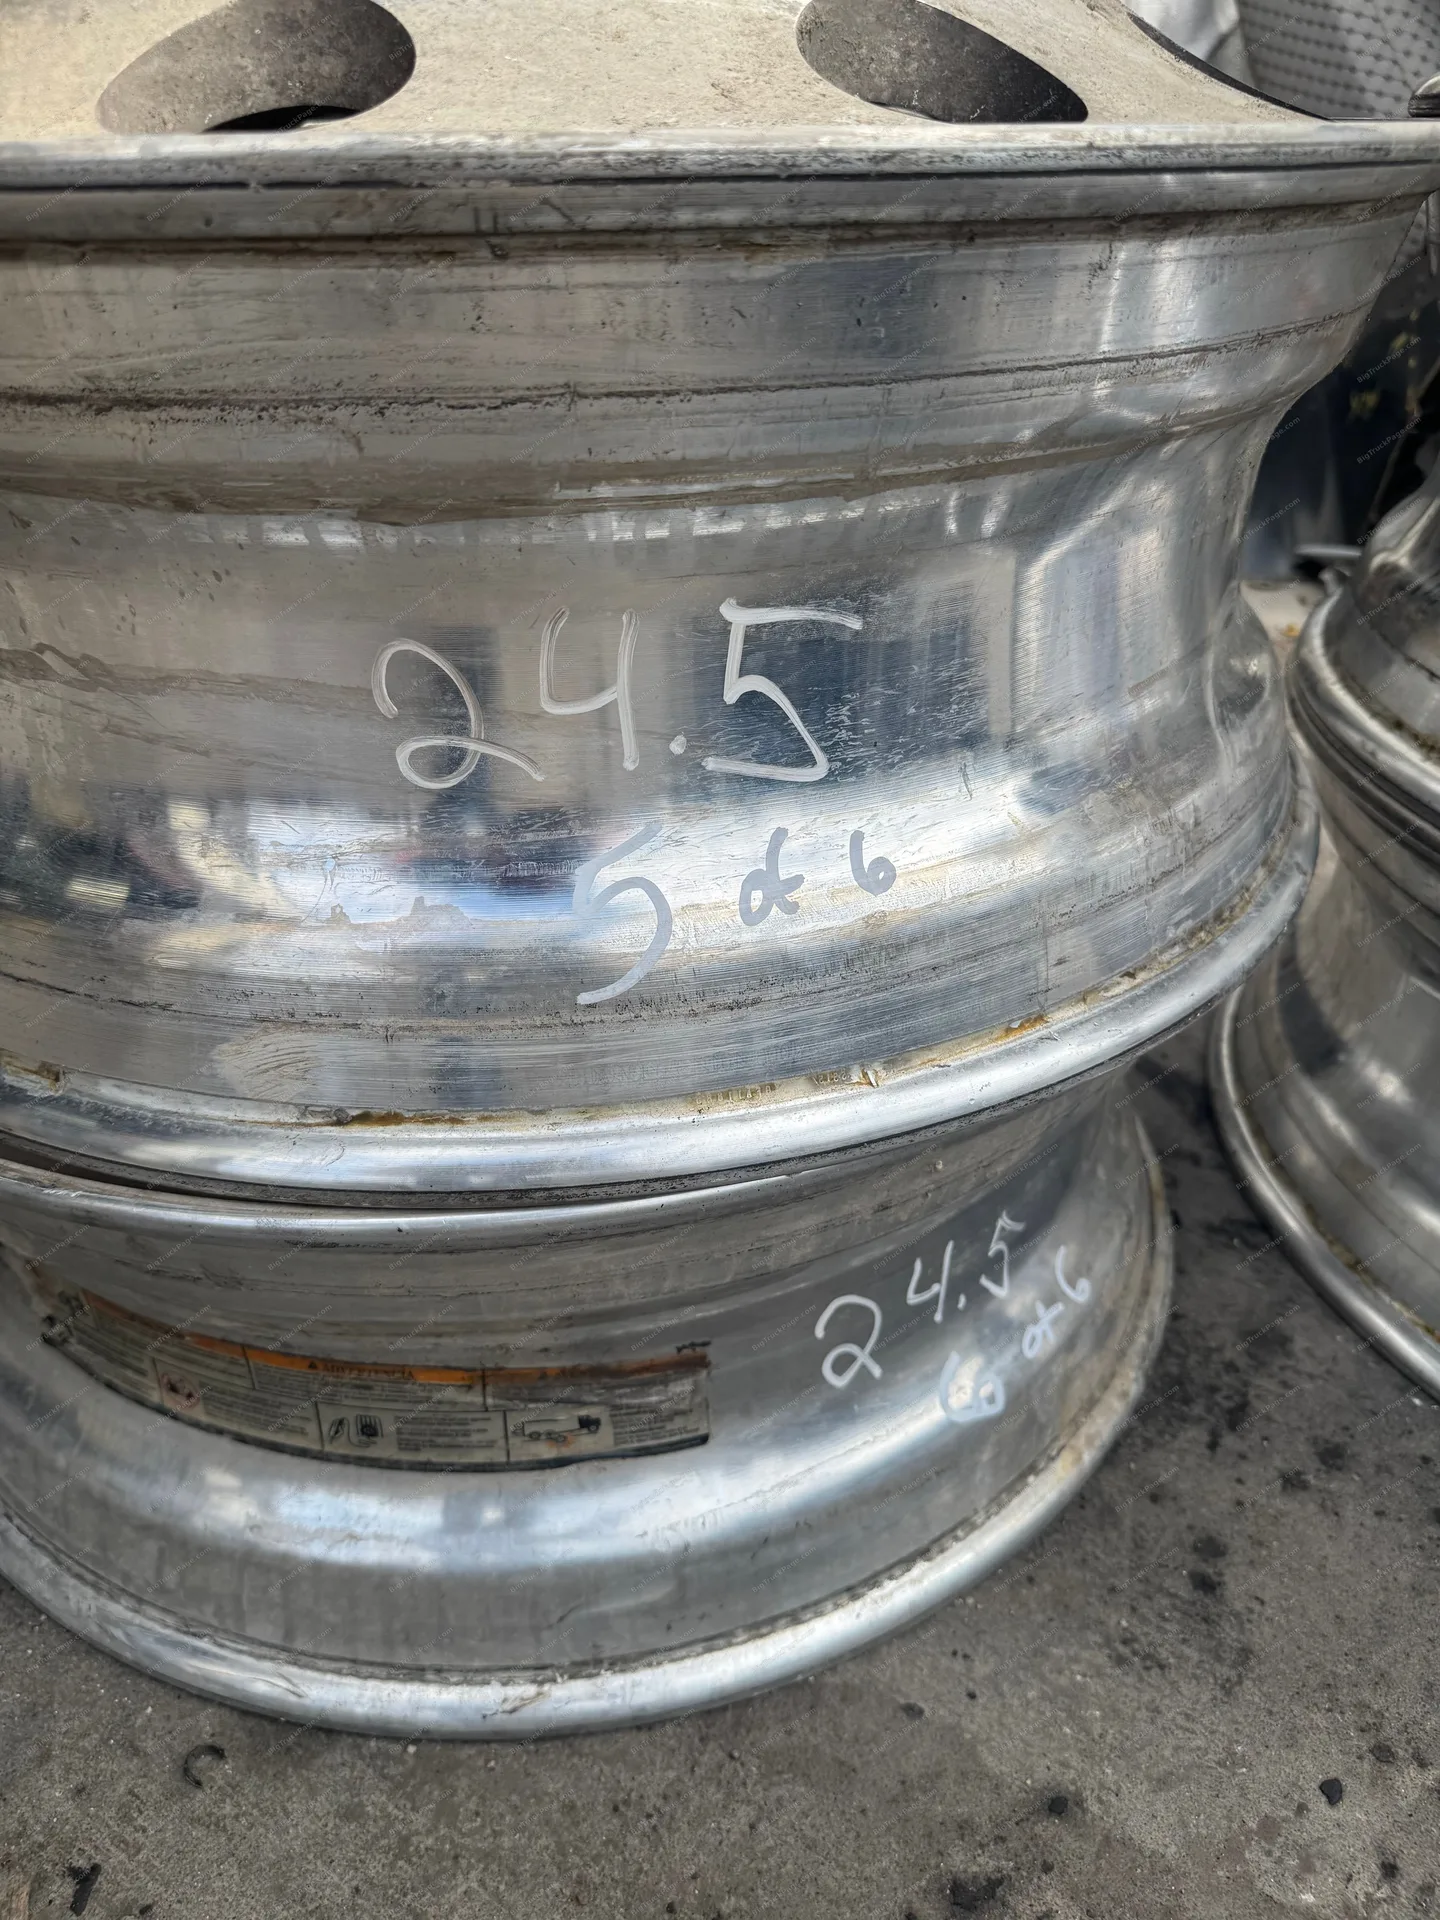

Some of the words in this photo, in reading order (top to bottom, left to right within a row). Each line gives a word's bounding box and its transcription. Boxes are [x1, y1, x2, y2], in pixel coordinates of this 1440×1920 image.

[371, 598, 863, 790] 24.5
[573, 823, 673, 1005] 5
[850, 830, 897, 896] 6
[814, 1209, 1027, 1389] 24.5
[1054, 1245, 1092, 1304] 6
